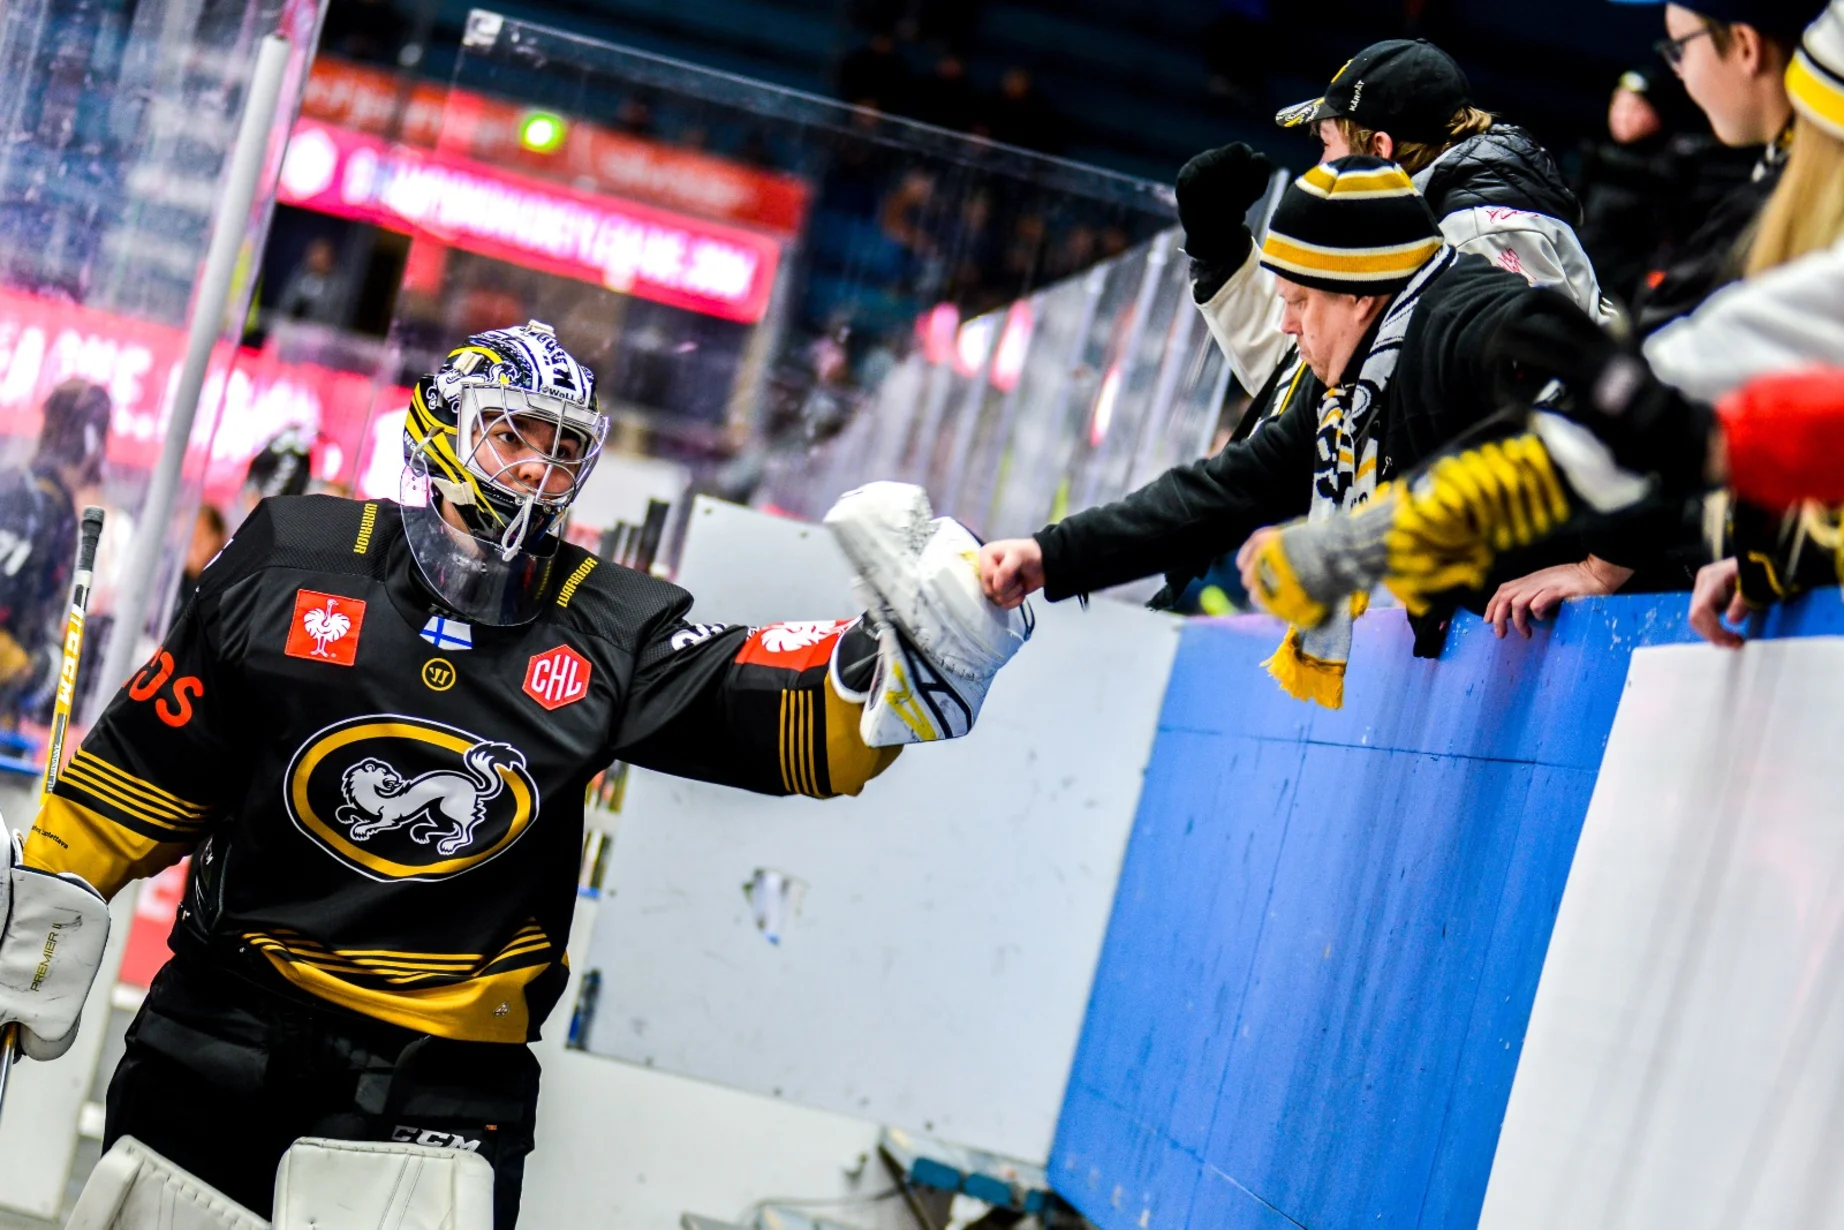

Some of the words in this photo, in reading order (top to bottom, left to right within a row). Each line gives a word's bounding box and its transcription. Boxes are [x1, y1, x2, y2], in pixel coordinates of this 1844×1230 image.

[353, 503, 378, 554] WARRIOR
[556, 557, 599, 608] WARRIOR
[58, 630, 80, 706] CCM
[530, 653, 583, 701] CHL
[30, 931, 59, 992] PREMIER
[391, 1124, 481, 1153] CCM
